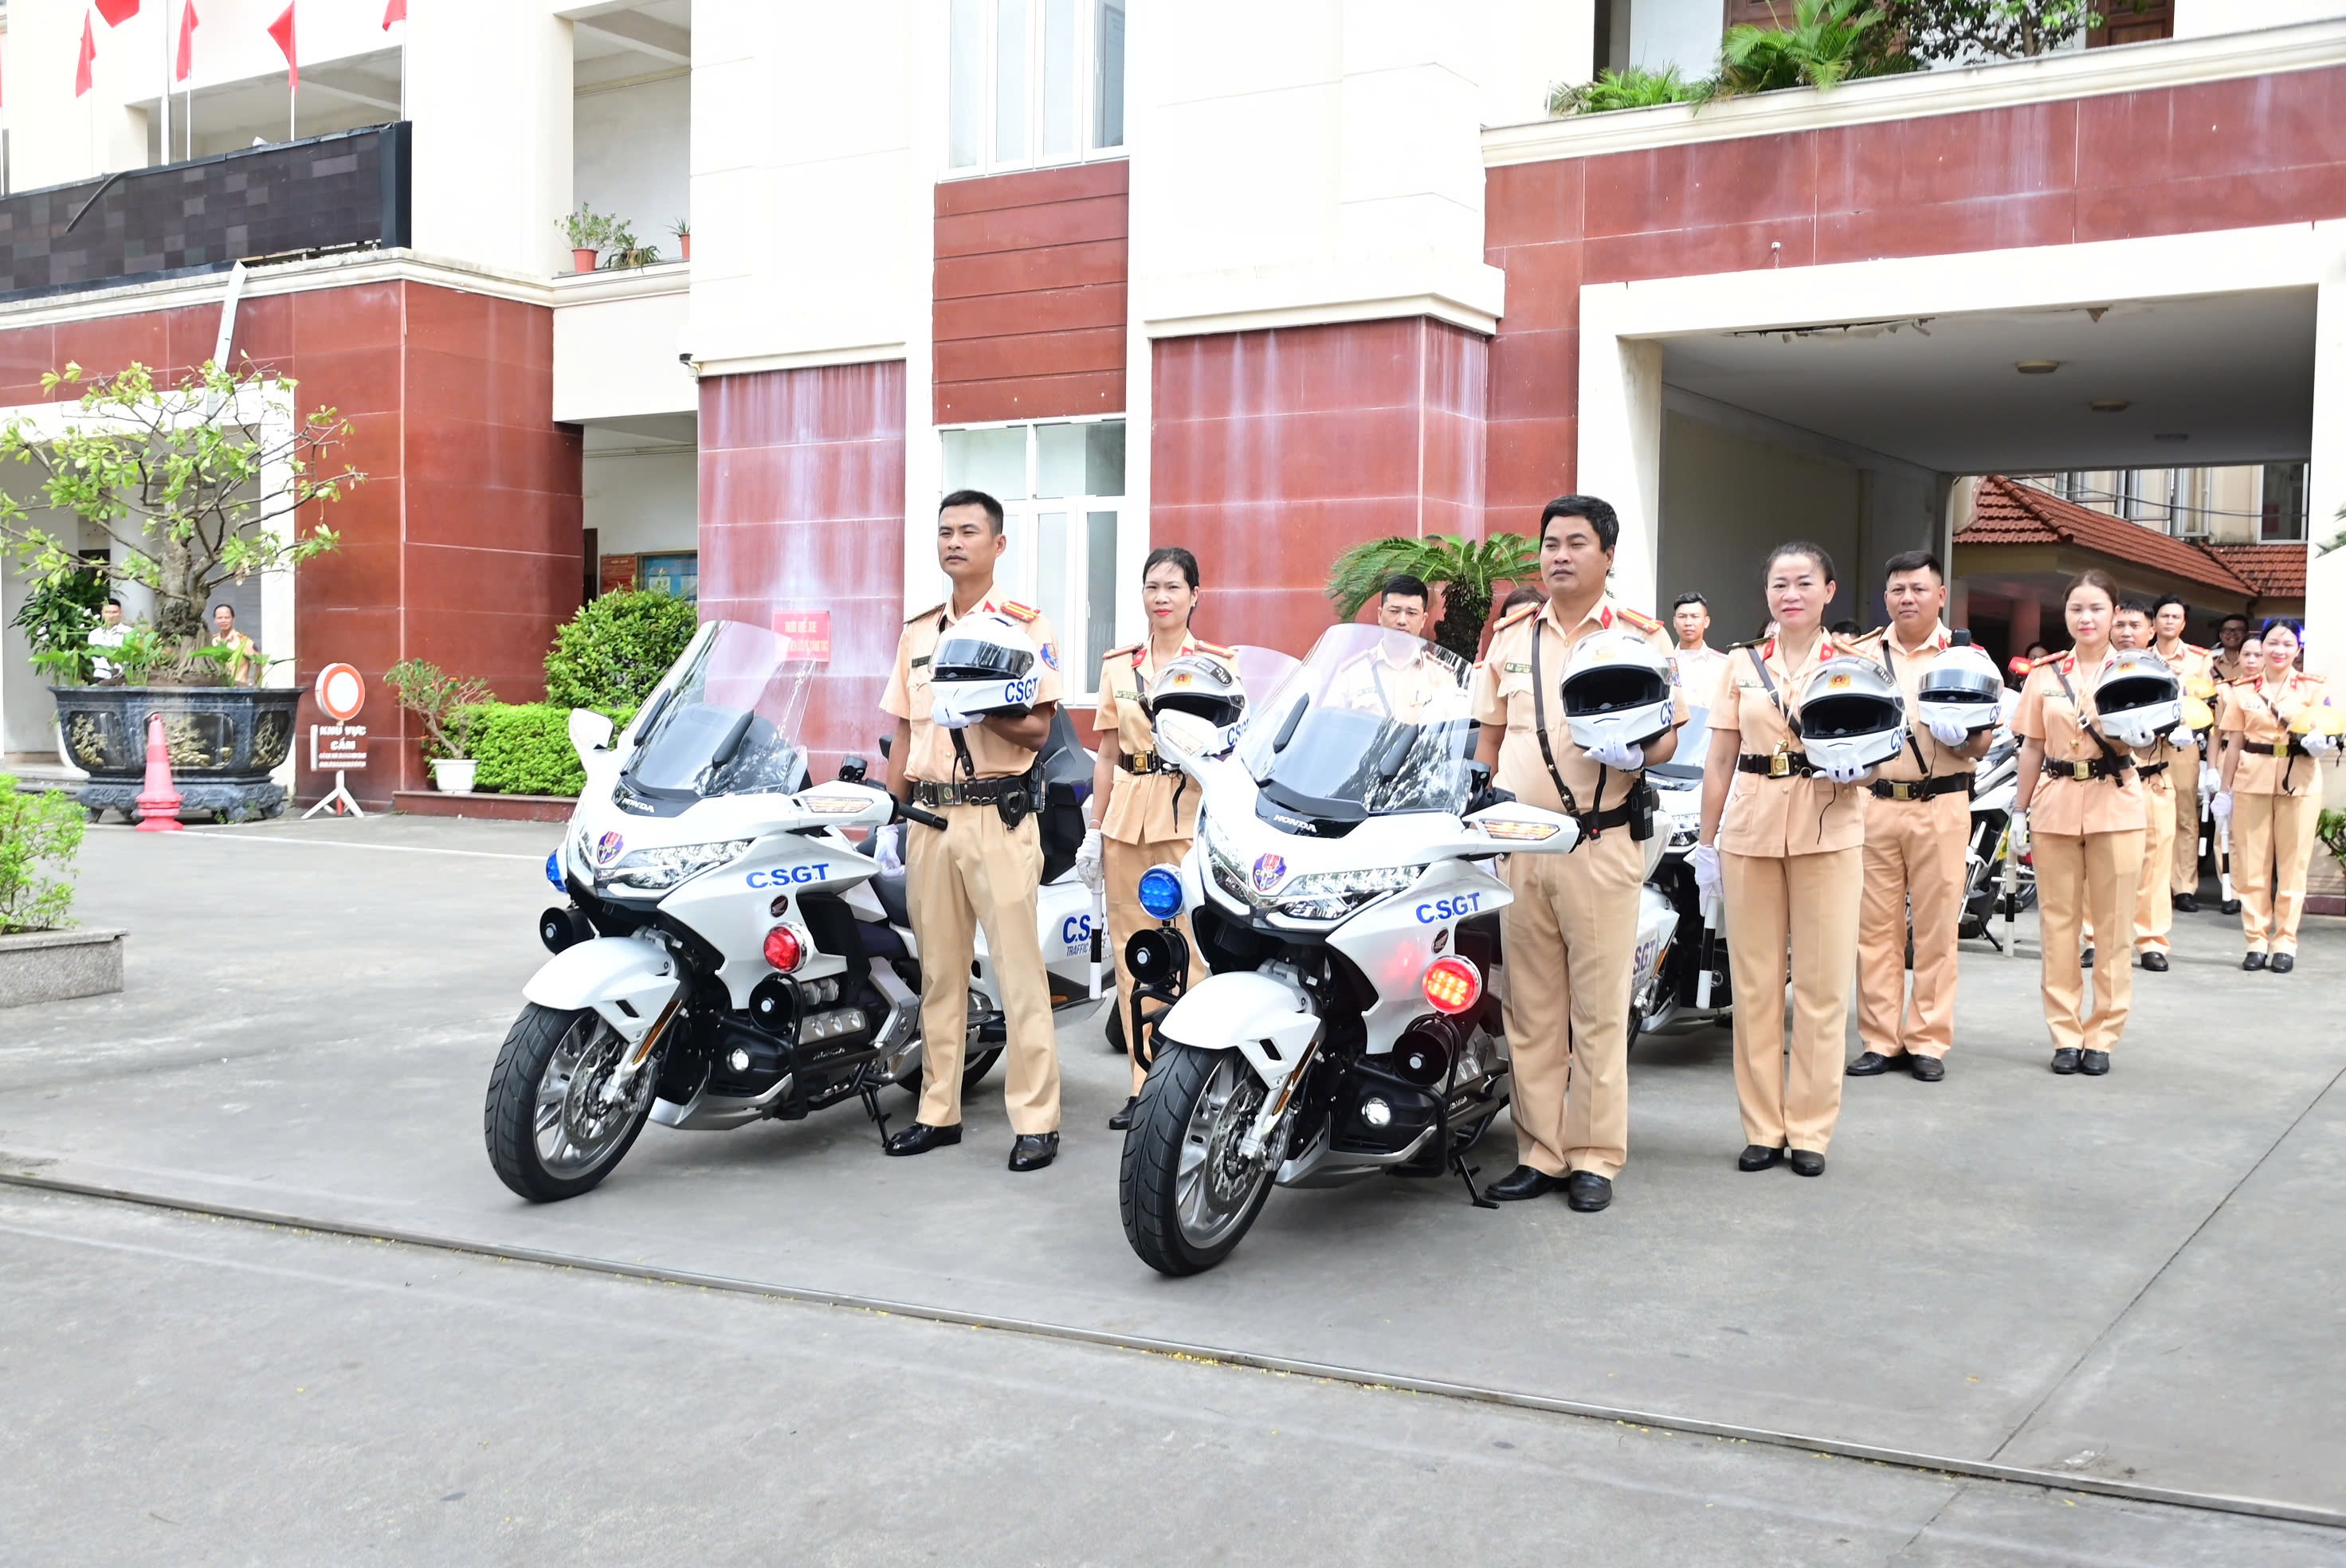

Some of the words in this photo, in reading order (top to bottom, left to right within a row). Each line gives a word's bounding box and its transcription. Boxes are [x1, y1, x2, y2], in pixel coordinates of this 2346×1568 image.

[1661, 701, 1674, 725] CS
[622, 798, 655, 813] HONDA
[1273, 814, 1317, 833] HONDA
[1066, 942, 1089, 956] TRAFFIC
